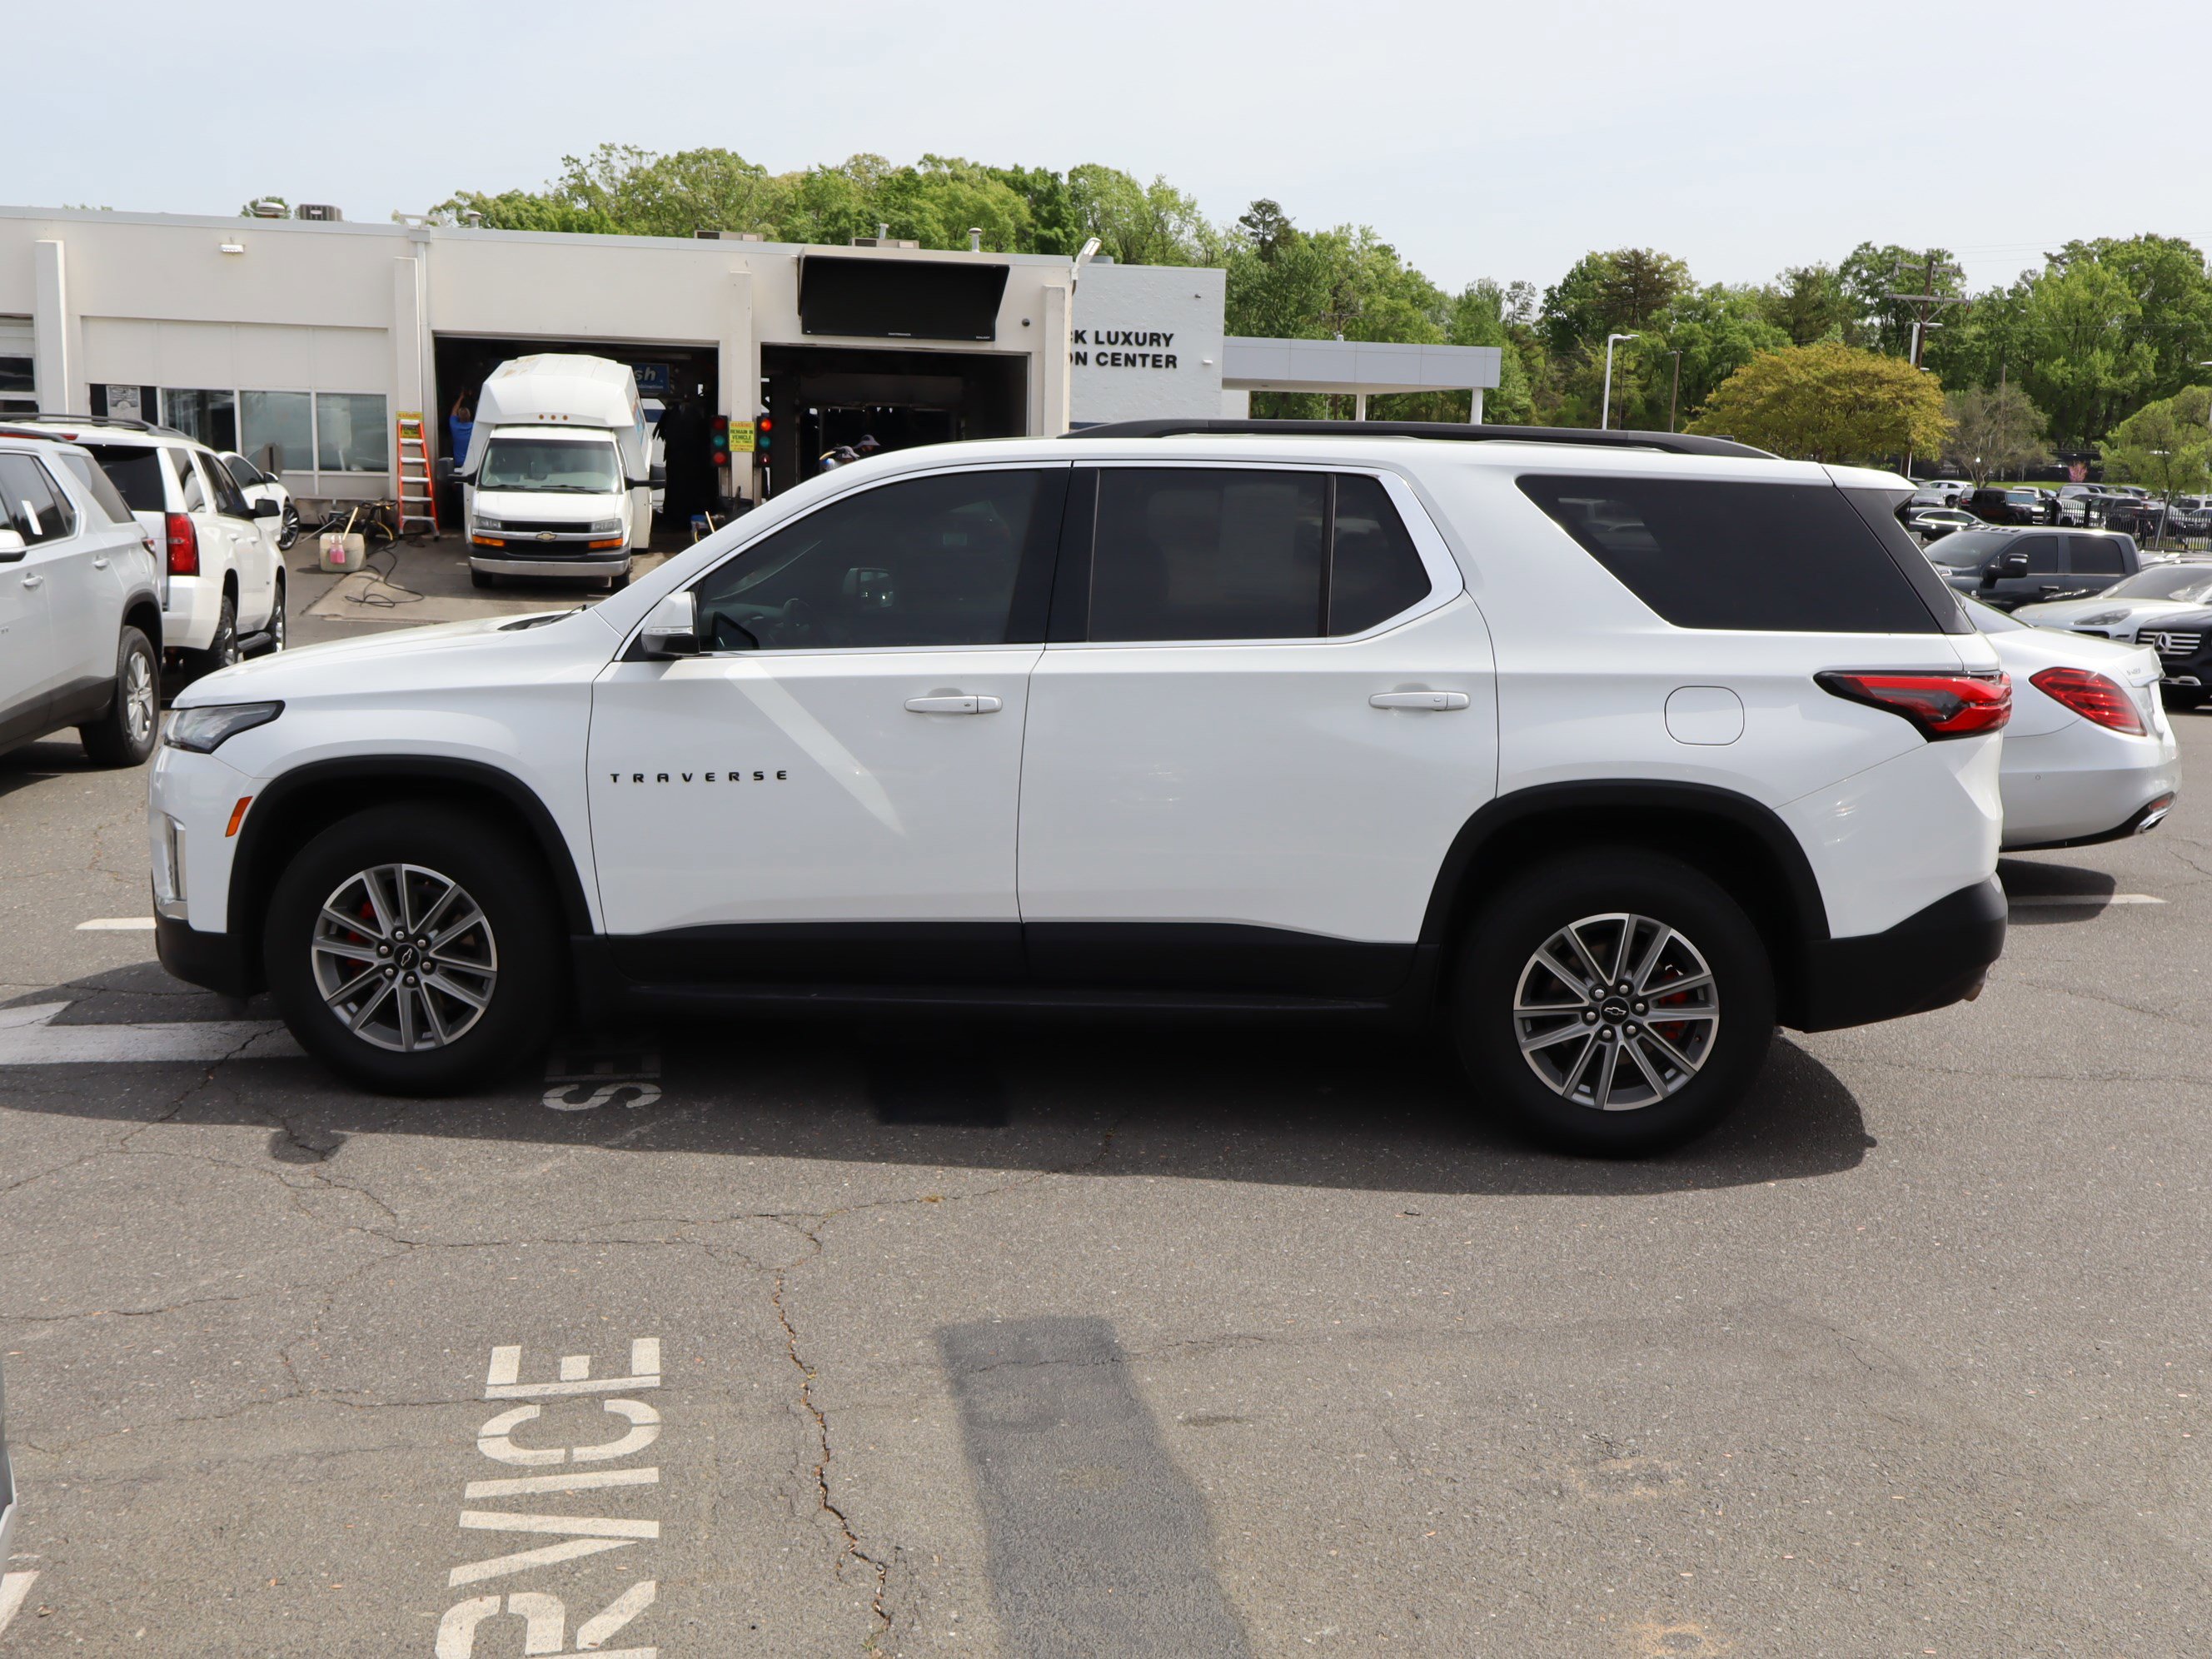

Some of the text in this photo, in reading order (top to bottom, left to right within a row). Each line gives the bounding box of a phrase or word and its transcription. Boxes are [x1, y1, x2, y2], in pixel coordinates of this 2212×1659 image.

[1071, 330, 1174, 347] K LUXURY
[1070, 351, 1178, 369] N CENTER
[610, 770, 787, 783] TRAVERSE
